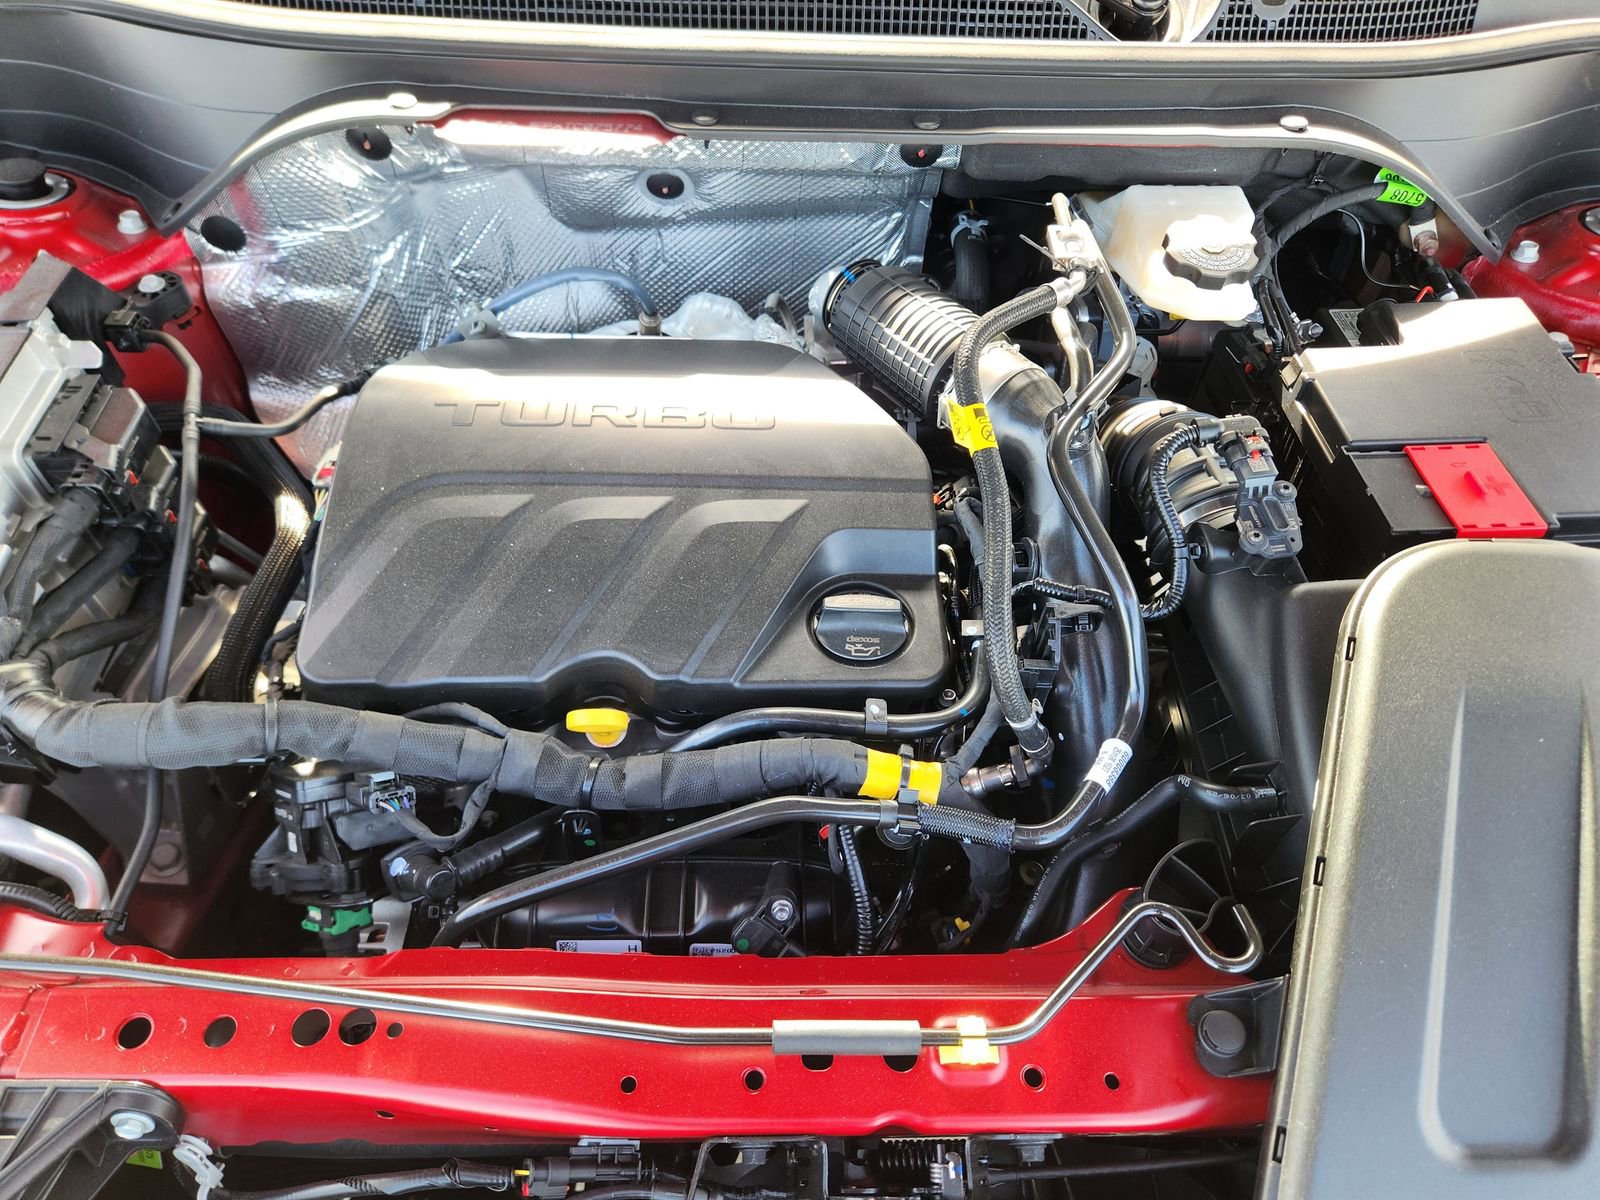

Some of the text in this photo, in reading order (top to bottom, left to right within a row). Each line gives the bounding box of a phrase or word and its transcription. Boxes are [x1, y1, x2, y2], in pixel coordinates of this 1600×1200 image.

[1390, 189, 1425, 205] 5708
[434, 401, 776, 431] TURBO
[846, 635, 881, 643] dexos
[1177, 775, 1192, 787] GM
